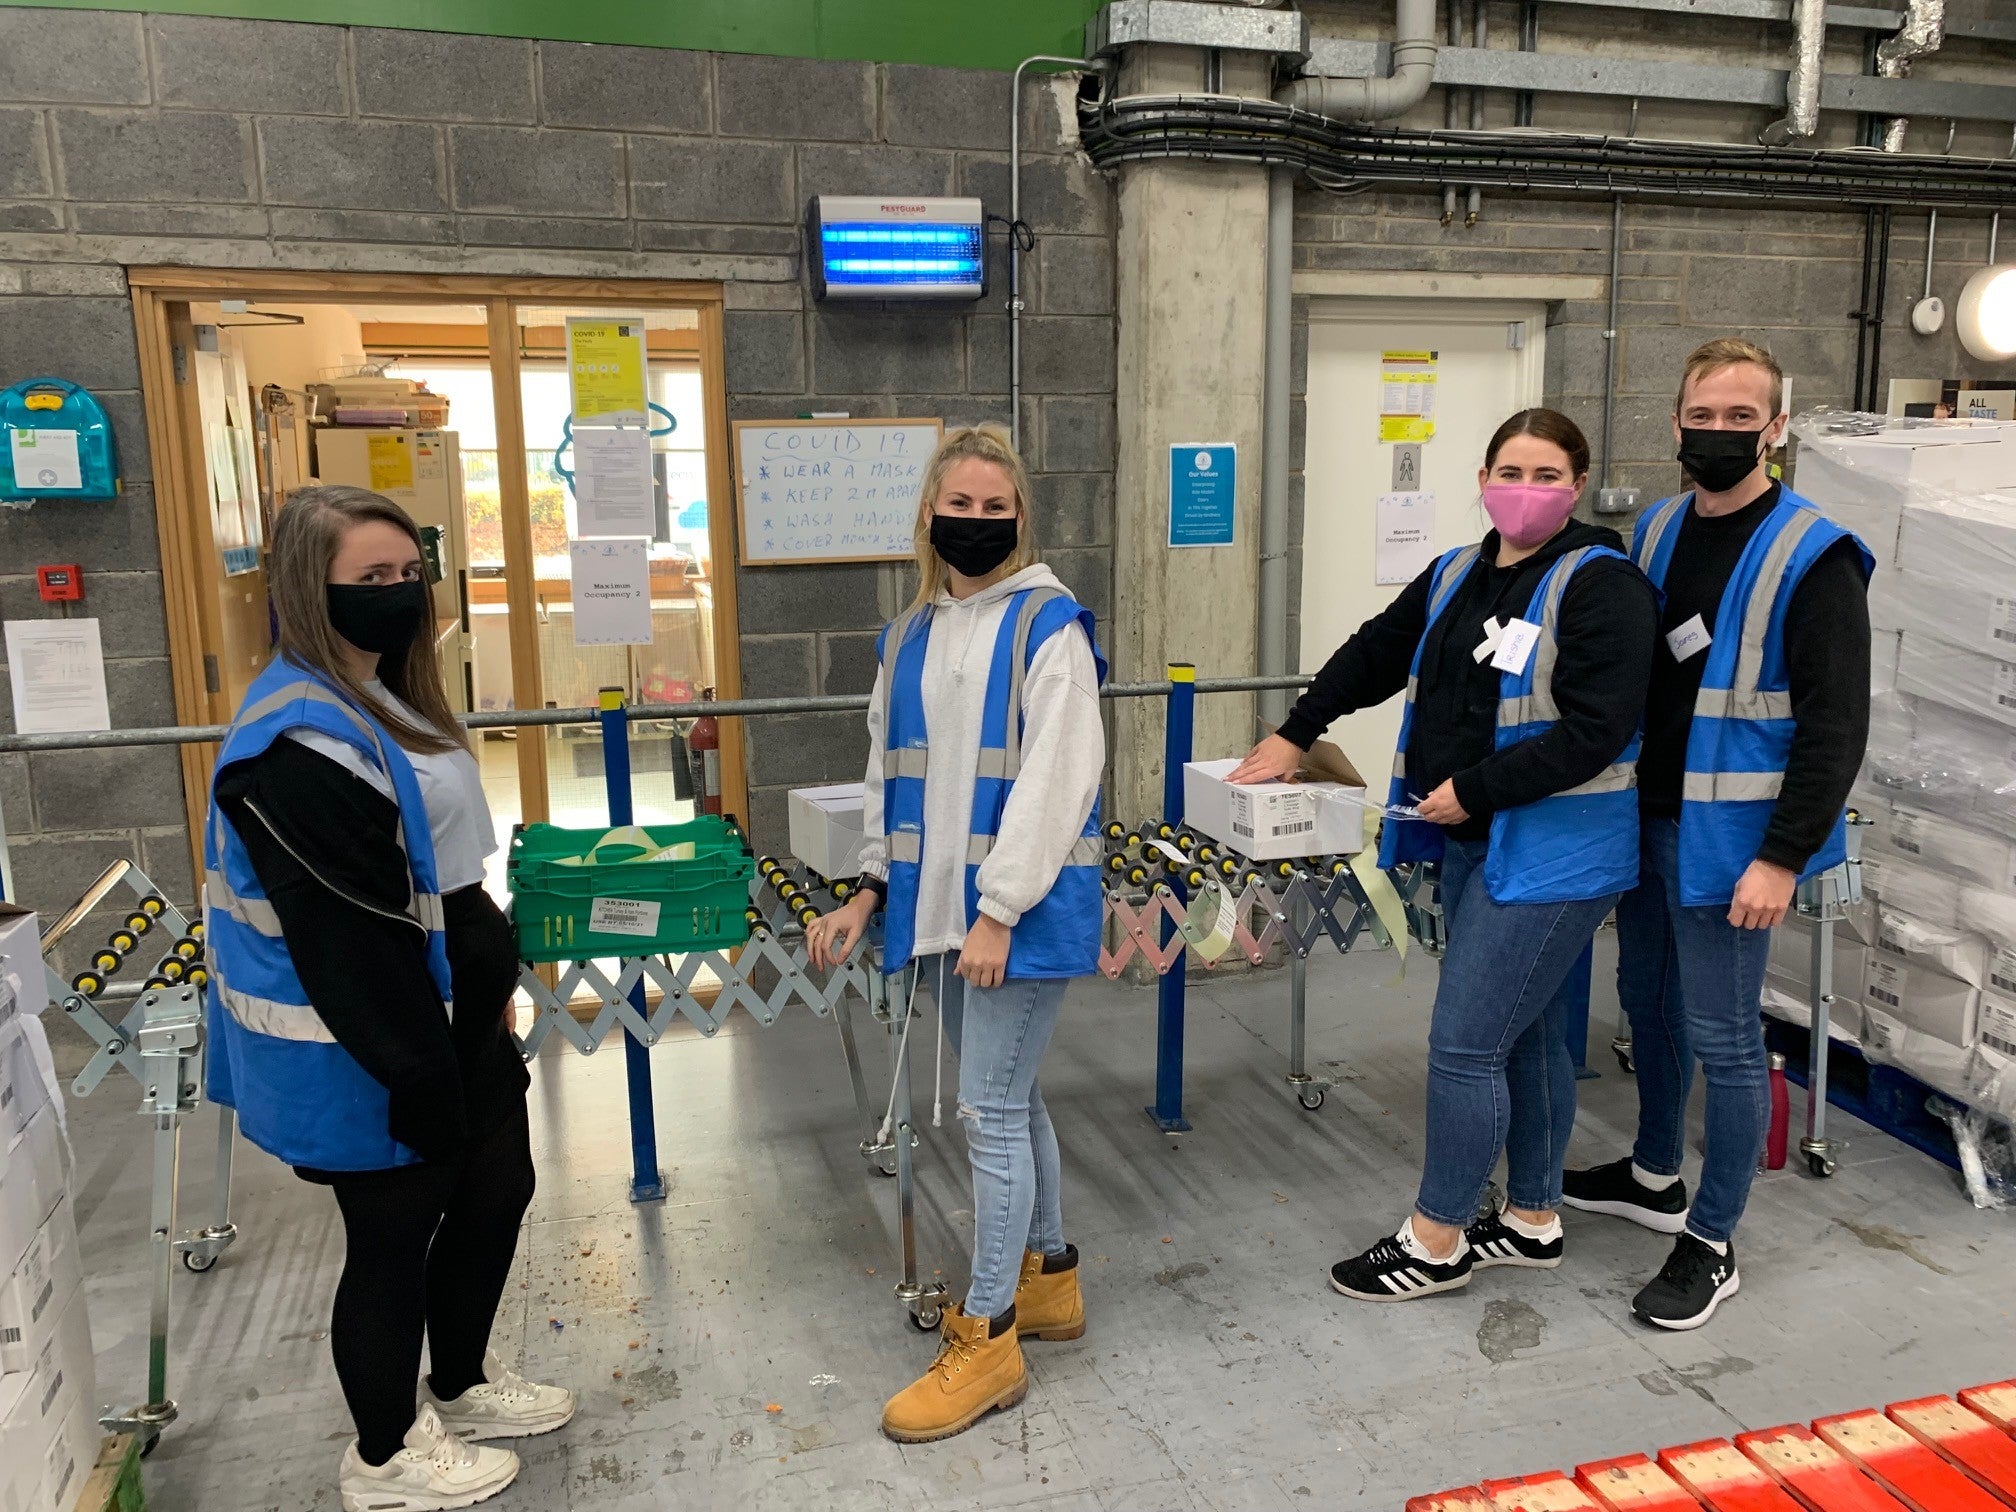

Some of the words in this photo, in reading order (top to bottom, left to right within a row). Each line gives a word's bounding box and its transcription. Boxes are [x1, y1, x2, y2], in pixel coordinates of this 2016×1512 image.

[1969, 398, 1986, 408] ALL
[1969, 409, 1998, 419] TASTE
[784, 461, 831, 478] WEAR
[844, 464, 855, 479] A
[871, 463, 917, 478] MASK
[786, 487, 833, 503] KEEP
[787, 512, 834, 527] WASH
[783, 534, 833, 551] COVER
[1385, 536, 1420, 544] Occupancy
[593, 582, 631, 590] Maximum
[584, 591, 631, 600] Occupancy
